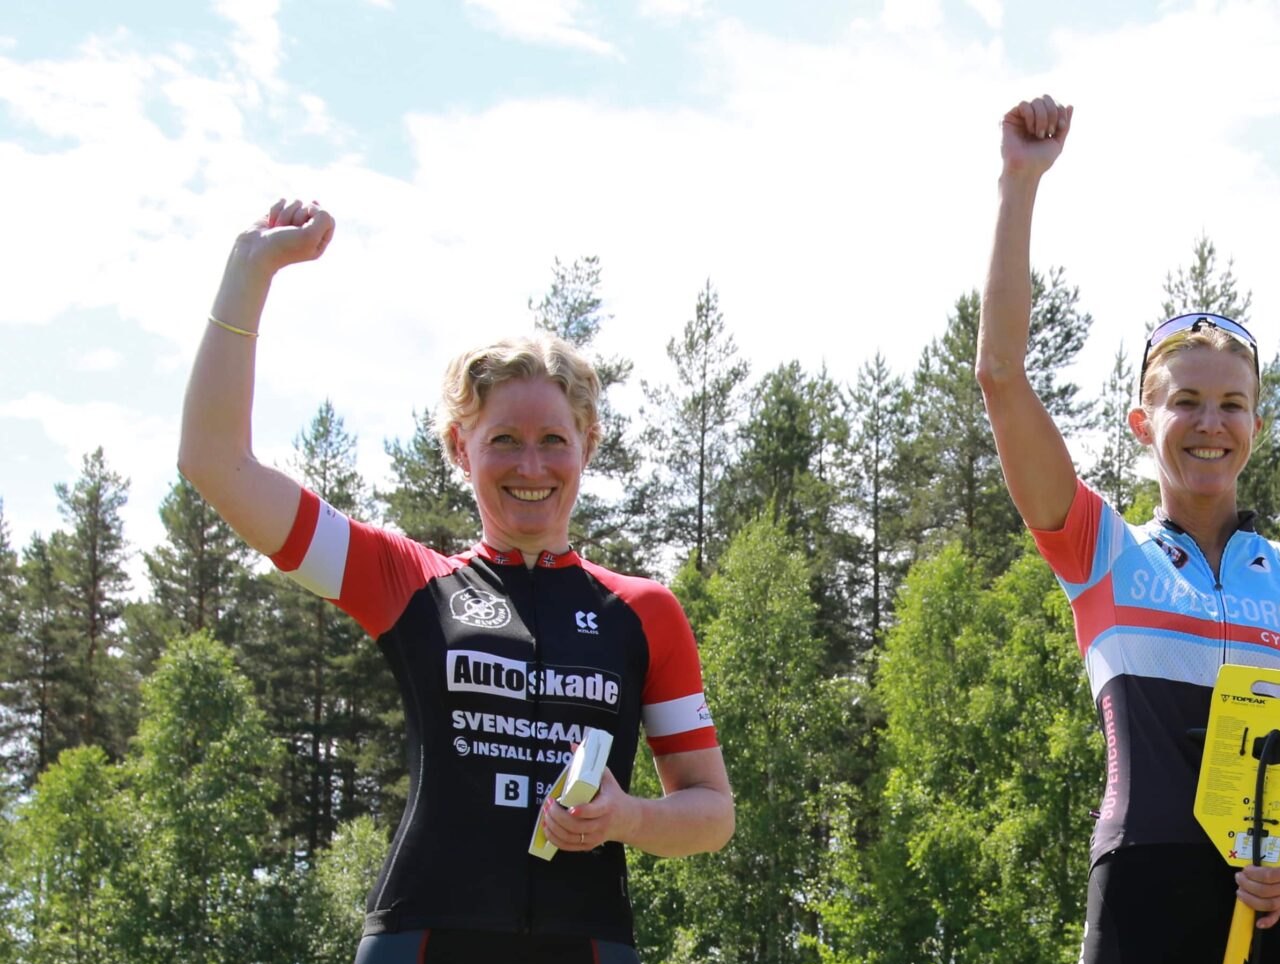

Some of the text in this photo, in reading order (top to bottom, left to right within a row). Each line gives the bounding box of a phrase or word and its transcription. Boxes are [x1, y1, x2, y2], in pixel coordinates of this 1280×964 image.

[1232, 695, 1266, 705] TOPEAK
[1101, 695, 1118, 820] SUPERCORSA
[505, 780, 520, 801] B
